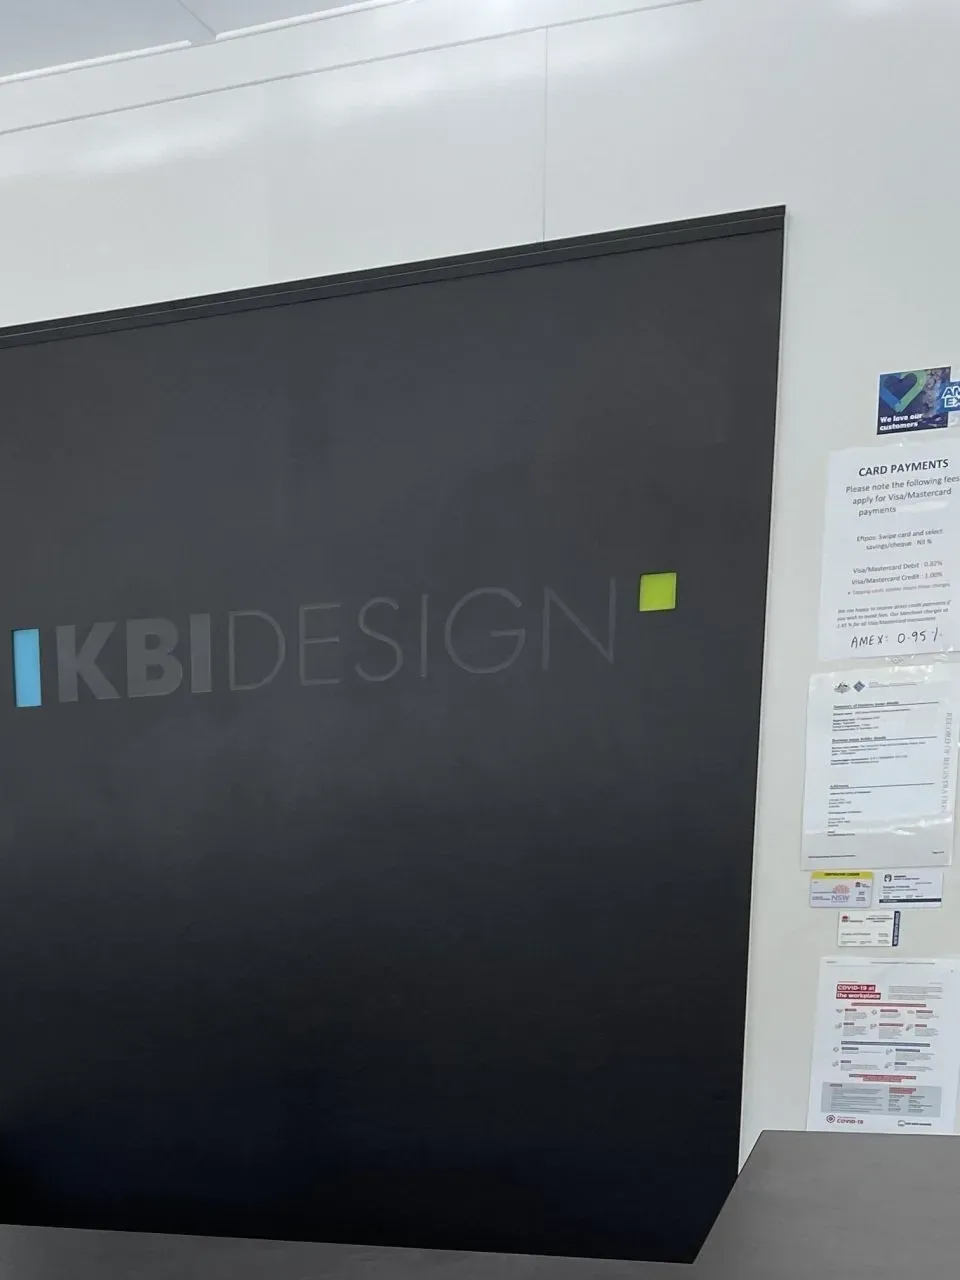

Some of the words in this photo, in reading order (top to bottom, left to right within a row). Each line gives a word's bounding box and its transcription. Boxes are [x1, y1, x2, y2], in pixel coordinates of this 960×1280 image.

[880, 416, 892, 424] We
[893, 414, 908, 422] love
[880, 421, 919, 431] customers
[858, 465, 888, 477] CARD
[890, 459, 949, 474] PAYMENTS
[846, 485, 870, 494] Please
[872, 483, 890, 491] note
[892, 480, 905, 488] the
[906, 477, 942, 488] following
[852, 496, 874, 505] apply
[875, 494, 886, 502] for
[888, 488, 952, 501] Visa/Mastercard
[858, 506, 896, 517] payments
